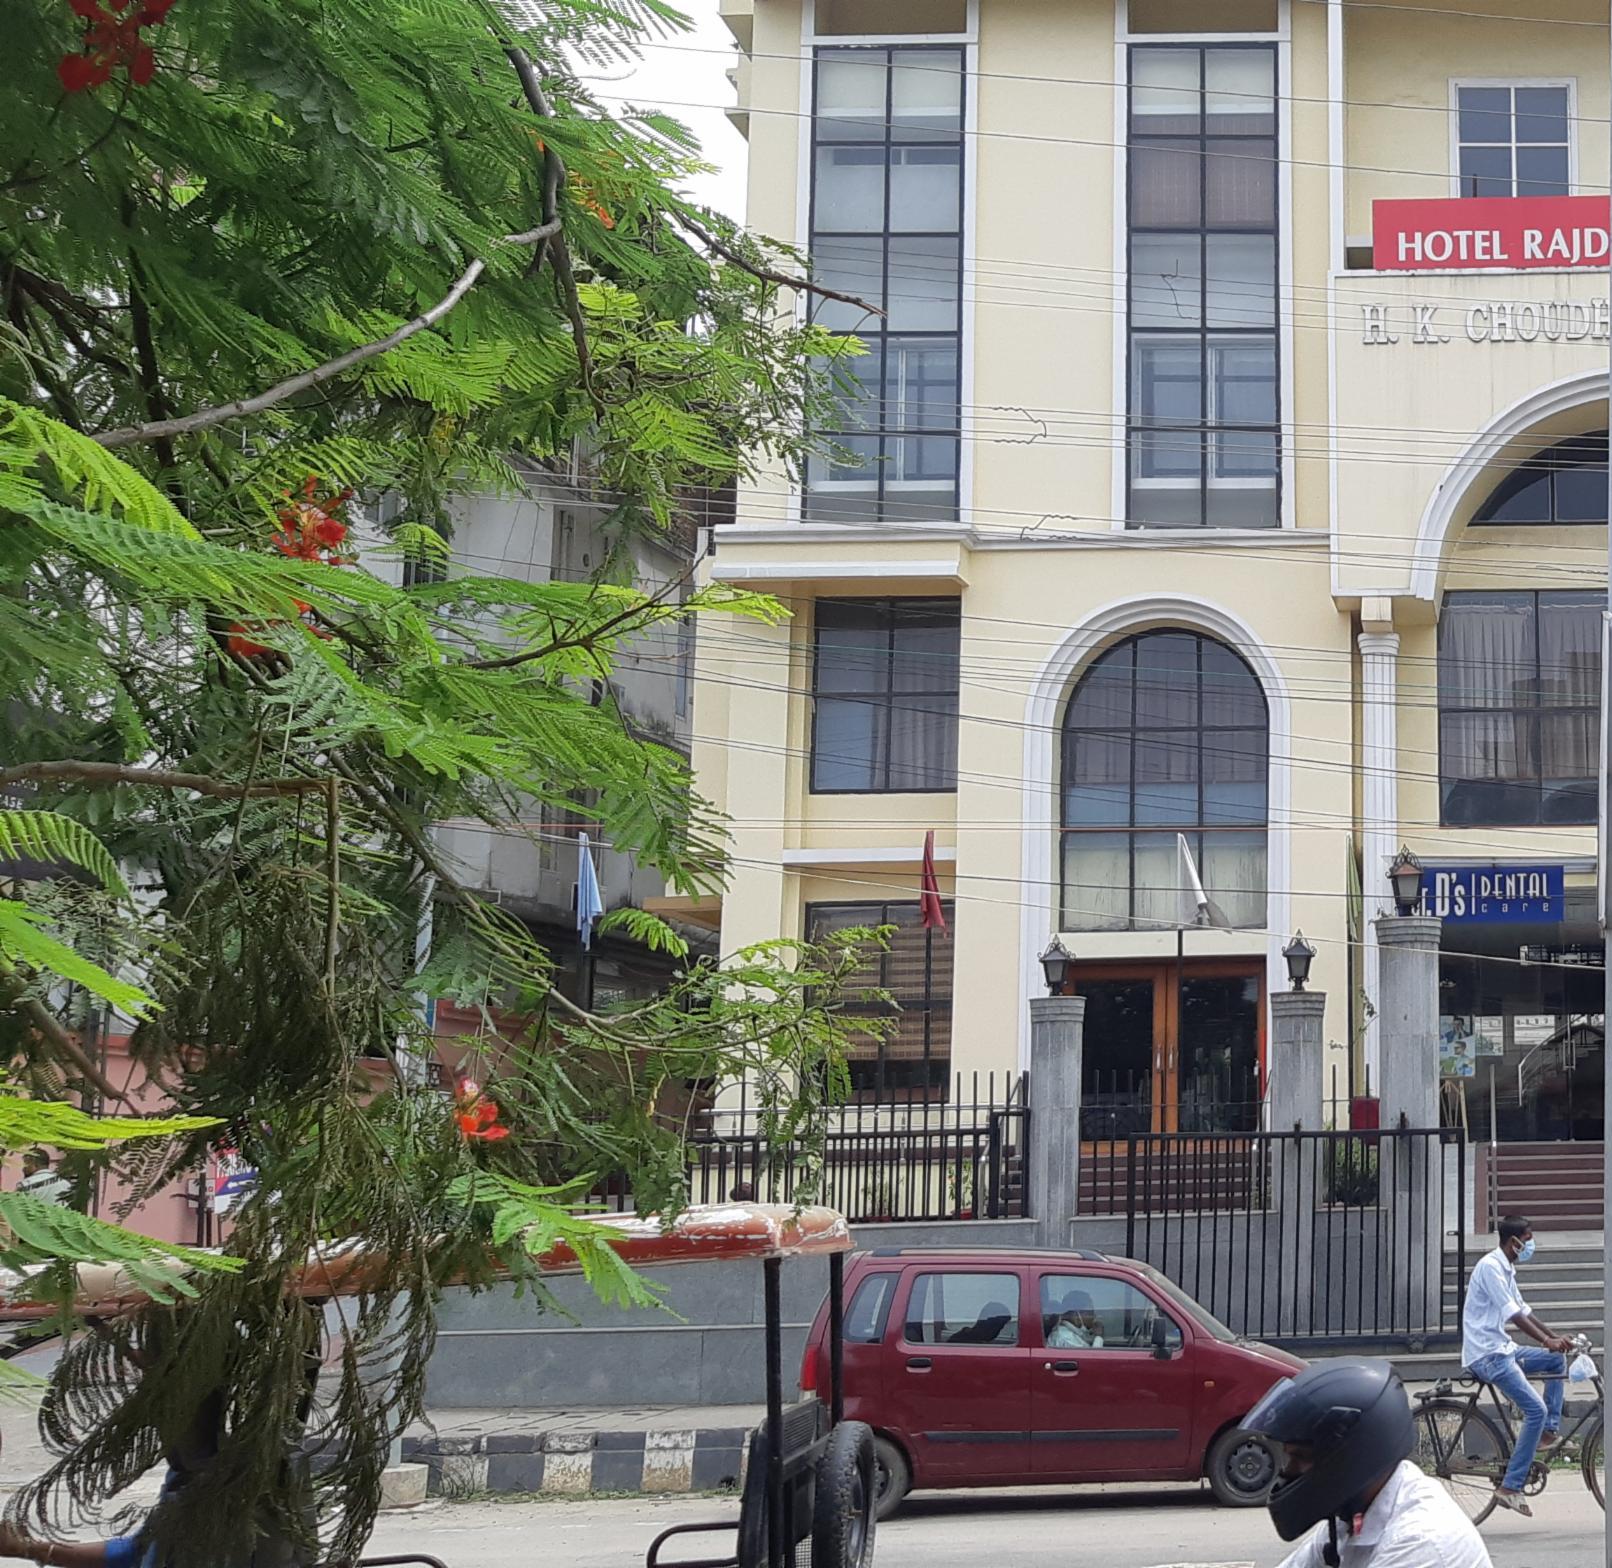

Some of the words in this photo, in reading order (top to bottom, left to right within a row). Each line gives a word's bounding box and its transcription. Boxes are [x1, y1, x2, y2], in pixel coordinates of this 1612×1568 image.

[1397, 230, 1508, 261] HOTEL
[1436, 872, 1465, 917] D's
[1480, 872, 1552, 899] DENTAL
[1481, 902, 1550, 913] care
